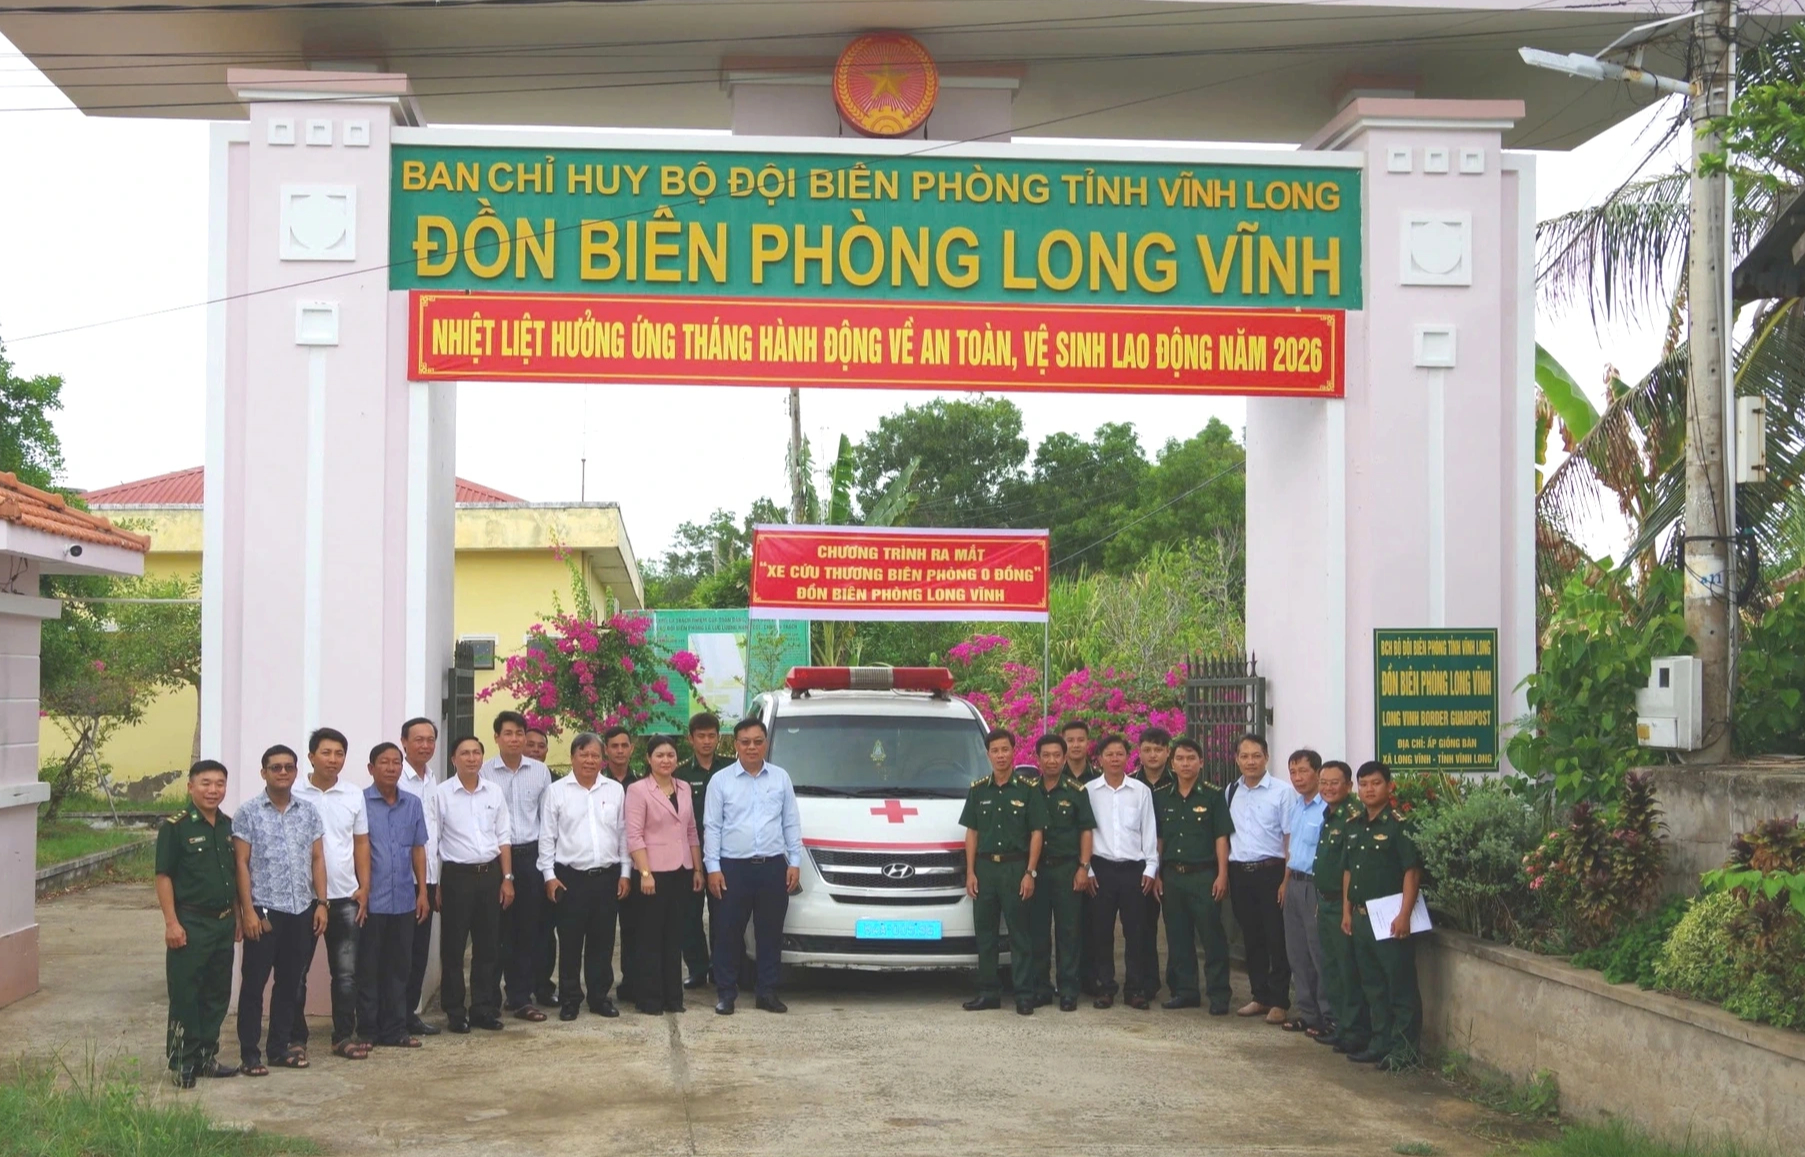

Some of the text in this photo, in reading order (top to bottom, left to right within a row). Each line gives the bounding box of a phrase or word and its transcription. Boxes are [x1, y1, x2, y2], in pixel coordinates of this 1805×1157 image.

[403, 156, 1340, 210] BAN CHỈ HUY BỘ ĐỘI BIÊN PHÒNG TỈNH VĨNH LONG
[412, 198, 1340, 296] ĐỒN BIÊN PHÒNG LONG VĨNH
[432, 309, 1322, 377] NHIỆT LIỆT HƯỞNG ỨNG THÁNG HÀNH ĐỘNG VỀ AN TOÀN, VỆ SINH LAO ĐỘNG NĂM 2026
[818, 545, 878, 560] CHƯƠNG
[883, 545, 926, 560] TRÌNH
[931, 548, 950, 561] RA
[790, 564, 820, 579] CỨU
[824, 566, 882, 580] THƯƠNG
[888, 566, 922, 581] BIÊN
[927, 567, 976, 581] PHÒNG
[832, 586, 866, 600] BIÊN
[872, 587, 922, 601] PHÒNG
[927, 588, 965, 601] LONG
[970, 586, 1004, 601] VĨNH
[1394, 637, 1401, 659] BỘ
[1403, 637, 1412, 659] ĐỘI
[1414, 637, 1426, 655] BIÊN
[1428, 636, 1446, 655] PHÒNG
[1448, 635, 1460, 655] TỈNH
[1462, 637, 1475, 655] VĨNH
[1476, 640, 1490, 655] LONG
[1382, 662, 1491, 696] ĐỒN BIÊN PHÒNG LONG VĨNH
[1383, 711, 1400, 726] LONG
[1421, 711, 1448, 726] BORDER
[1451, 710, 1491, 726] GUARDPOST
[1397, 739, 1409, 750] ĐỊA
[1412, 736, 1425, 748] CHỈ:
[1427, 736, 1436, 748] ẤP
[1383, 753, 1392, 764] XÃ
[1394, 755, 1412, 764] LONG
[1414, 753, 1431, 764] VĨNH
[1438, 752, 1453, 764] TỈNH
[1455, 753, 1472, 764] VĨNH
[1474, 754, 1492, 763] LONG
